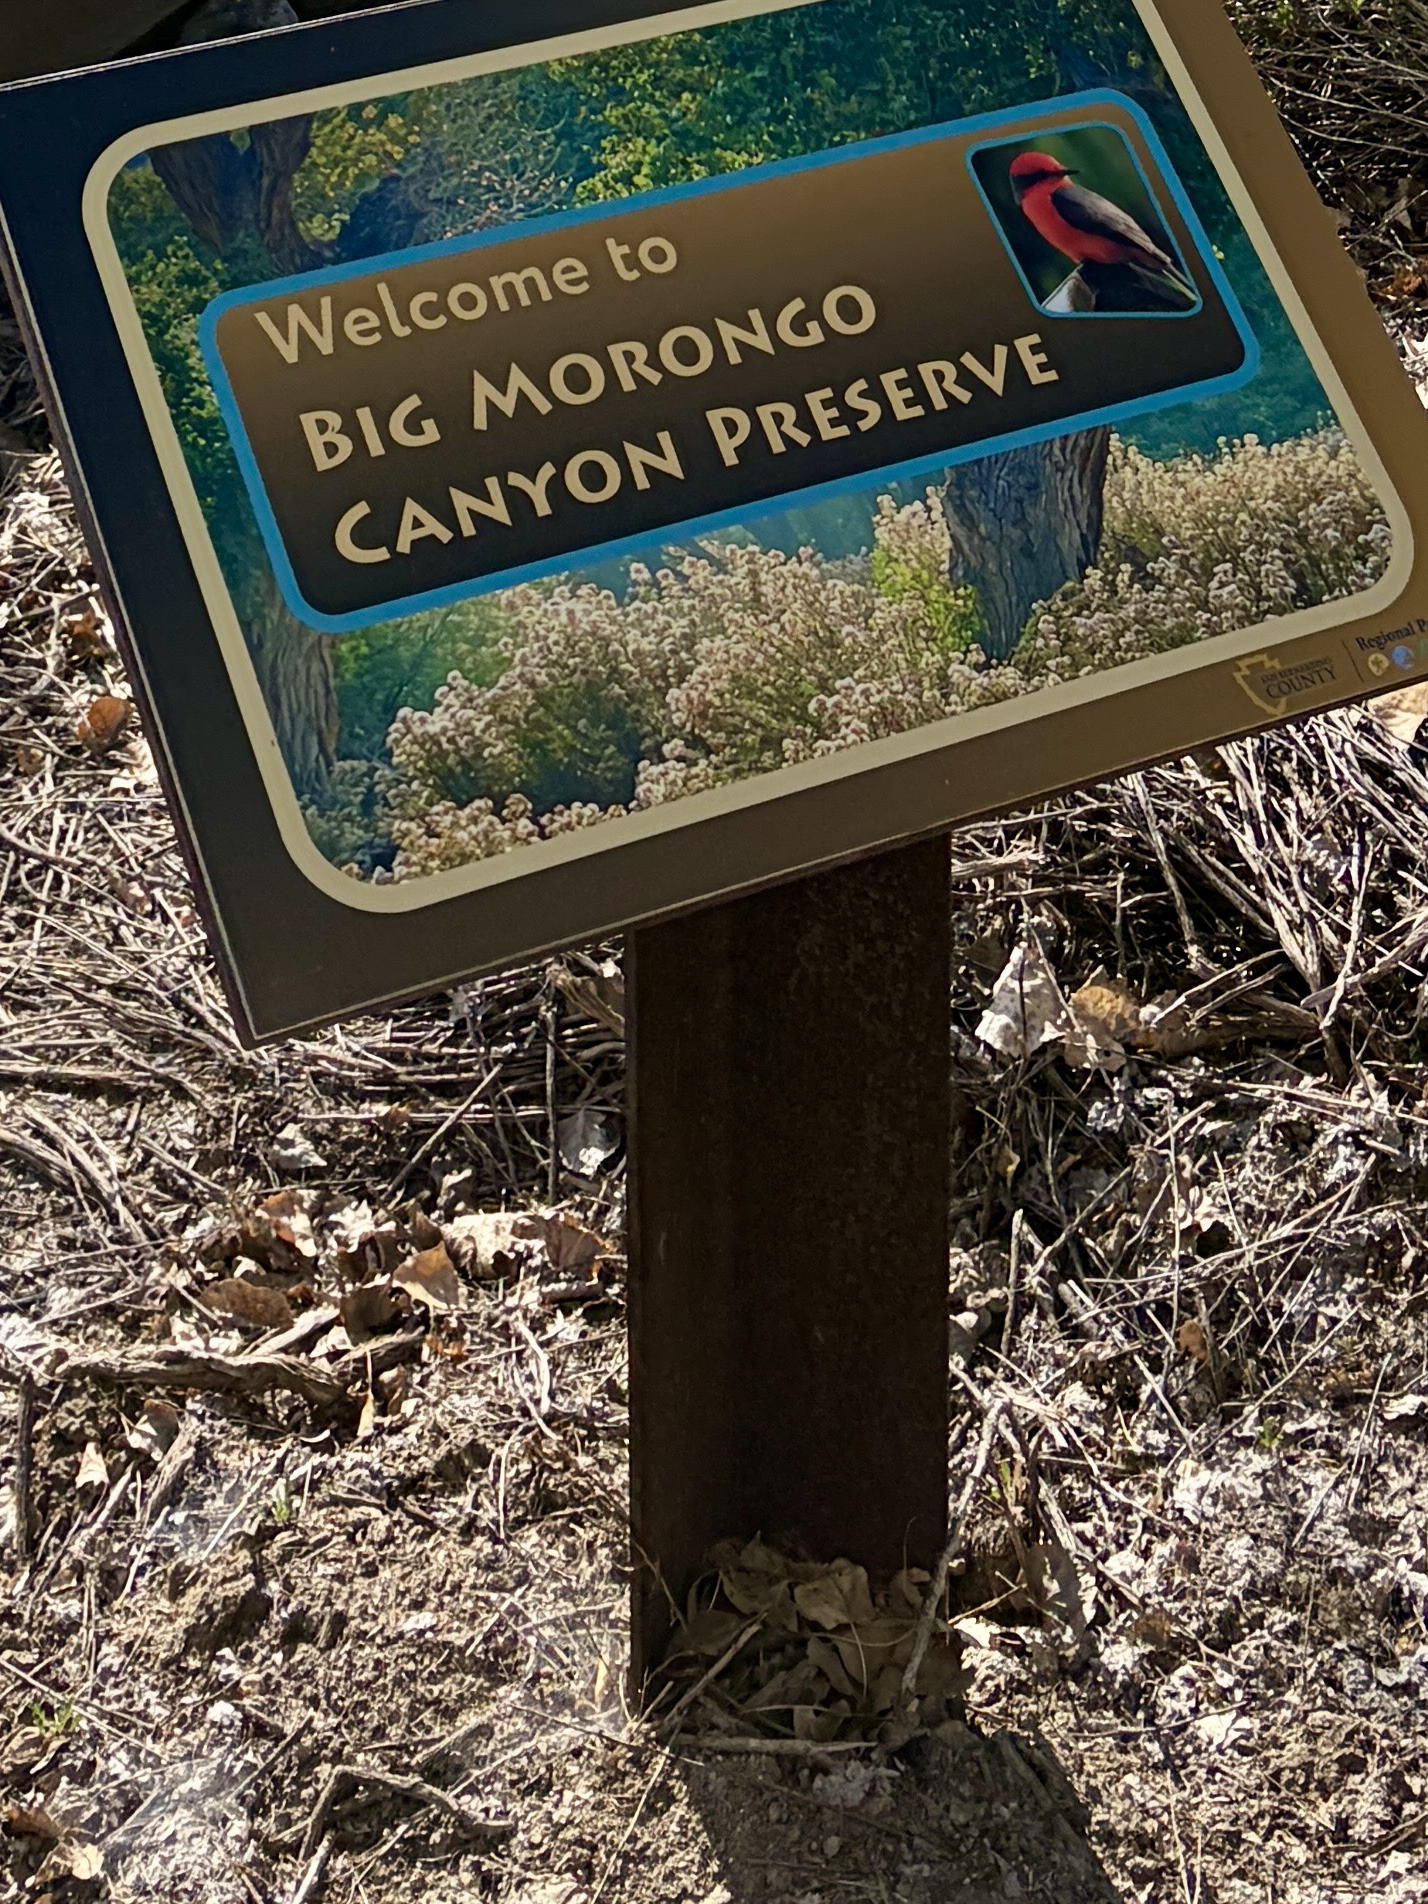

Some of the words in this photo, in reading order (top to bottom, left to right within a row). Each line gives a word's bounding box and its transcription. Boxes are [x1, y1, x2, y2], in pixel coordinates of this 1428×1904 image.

[253, 256, 591, 365] Welcome
[604, 235, 678, 282] to
[298, 394, 442, 473] BIG
[471, 284, 877, 432] MORONGO
[334, 429, 685, 564] CANYON
[704, 332, 1060, 467] PRESERVE
[1266, 665, 1337, 699] COUNTY
[1355, 620, 1416, 651] Regional
